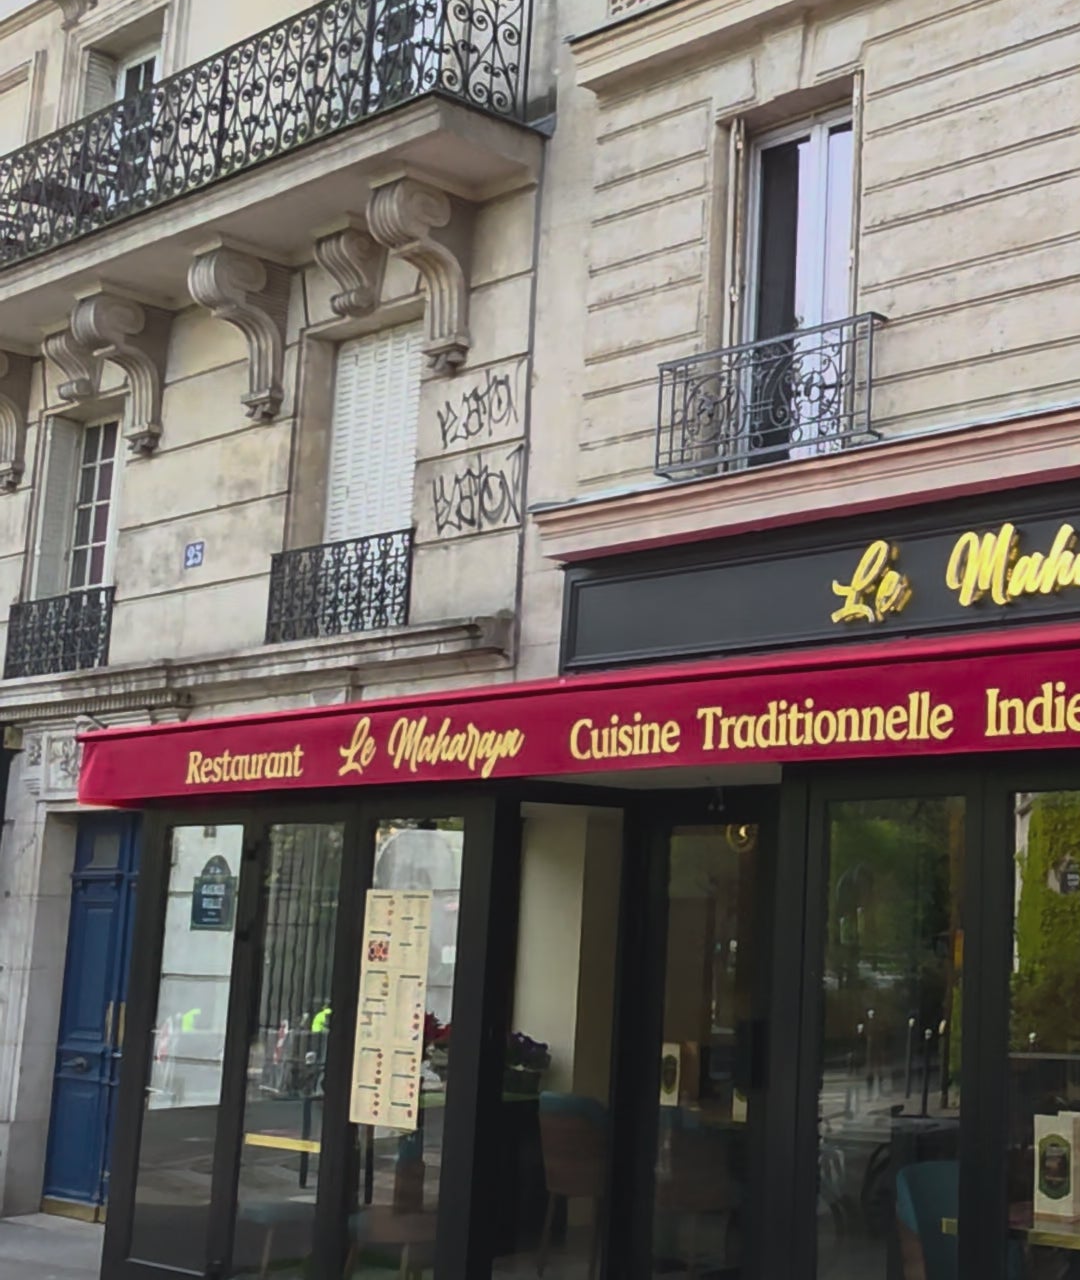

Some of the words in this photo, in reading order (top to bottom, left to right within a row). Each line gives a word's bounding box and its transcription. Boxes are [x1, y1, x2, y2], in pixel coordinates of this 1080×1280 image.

[831, 540, 900, 623] Le
[184, 744, 304, 784] Restaurant
[338, 716, 377, 776] Le
[569, 711, 681, 760] Cuisine
[696, 691, 954, 751] Traditionnelle
